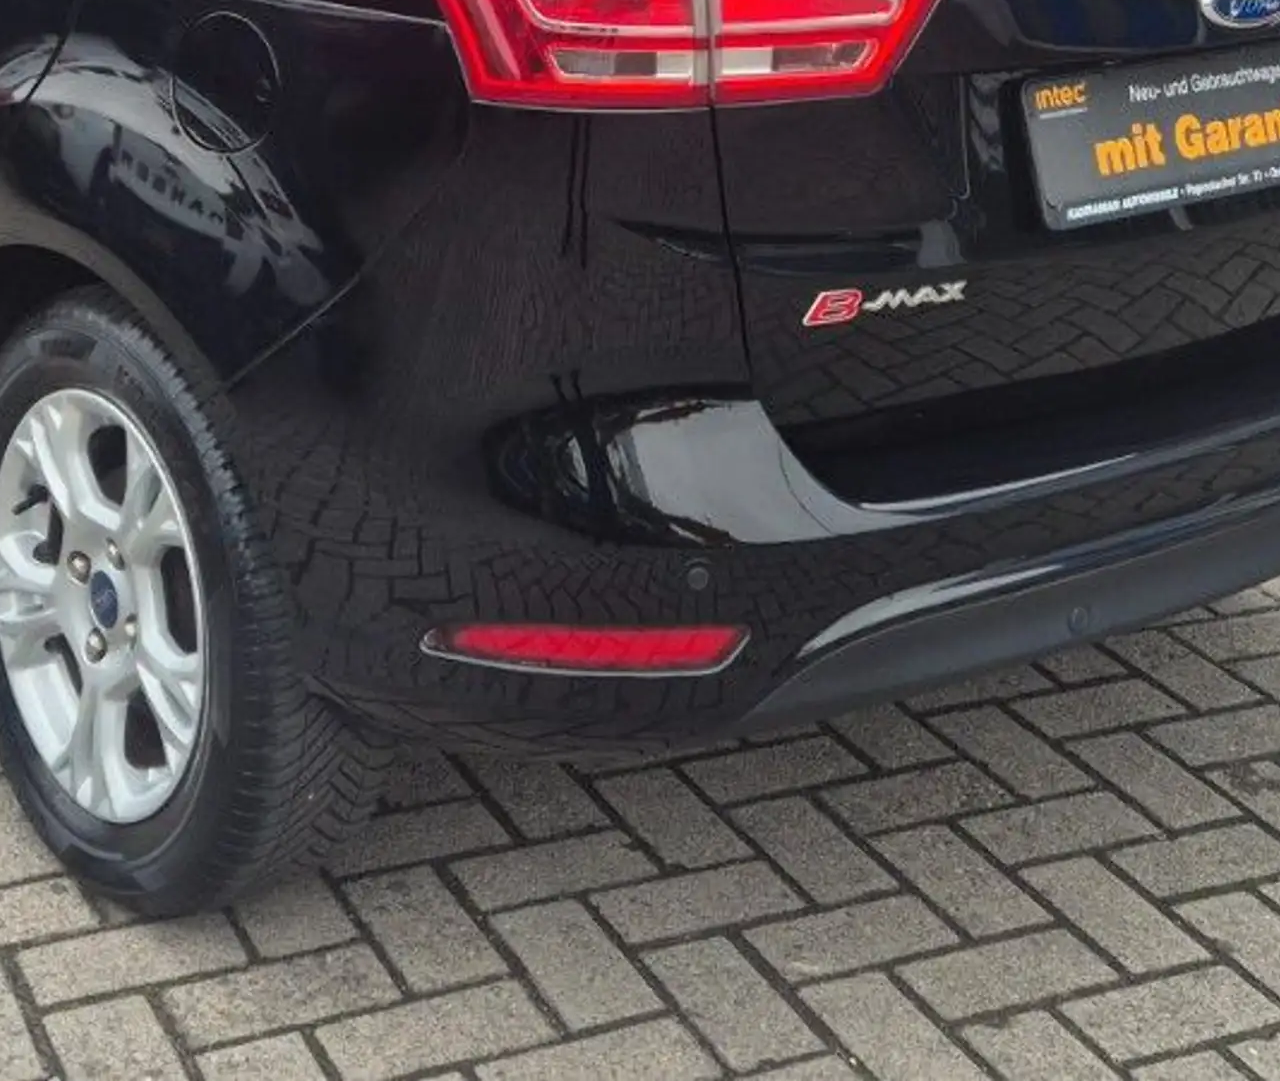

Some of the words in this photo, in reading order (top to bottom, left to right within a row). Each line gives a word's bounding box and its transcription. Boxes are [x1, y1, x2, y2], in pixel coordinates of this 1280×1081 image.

[1128, 83, 1161, 103] Neu-
[1163, 75, 1188, 98] und
[1094, 122, 1167, 176] mit
